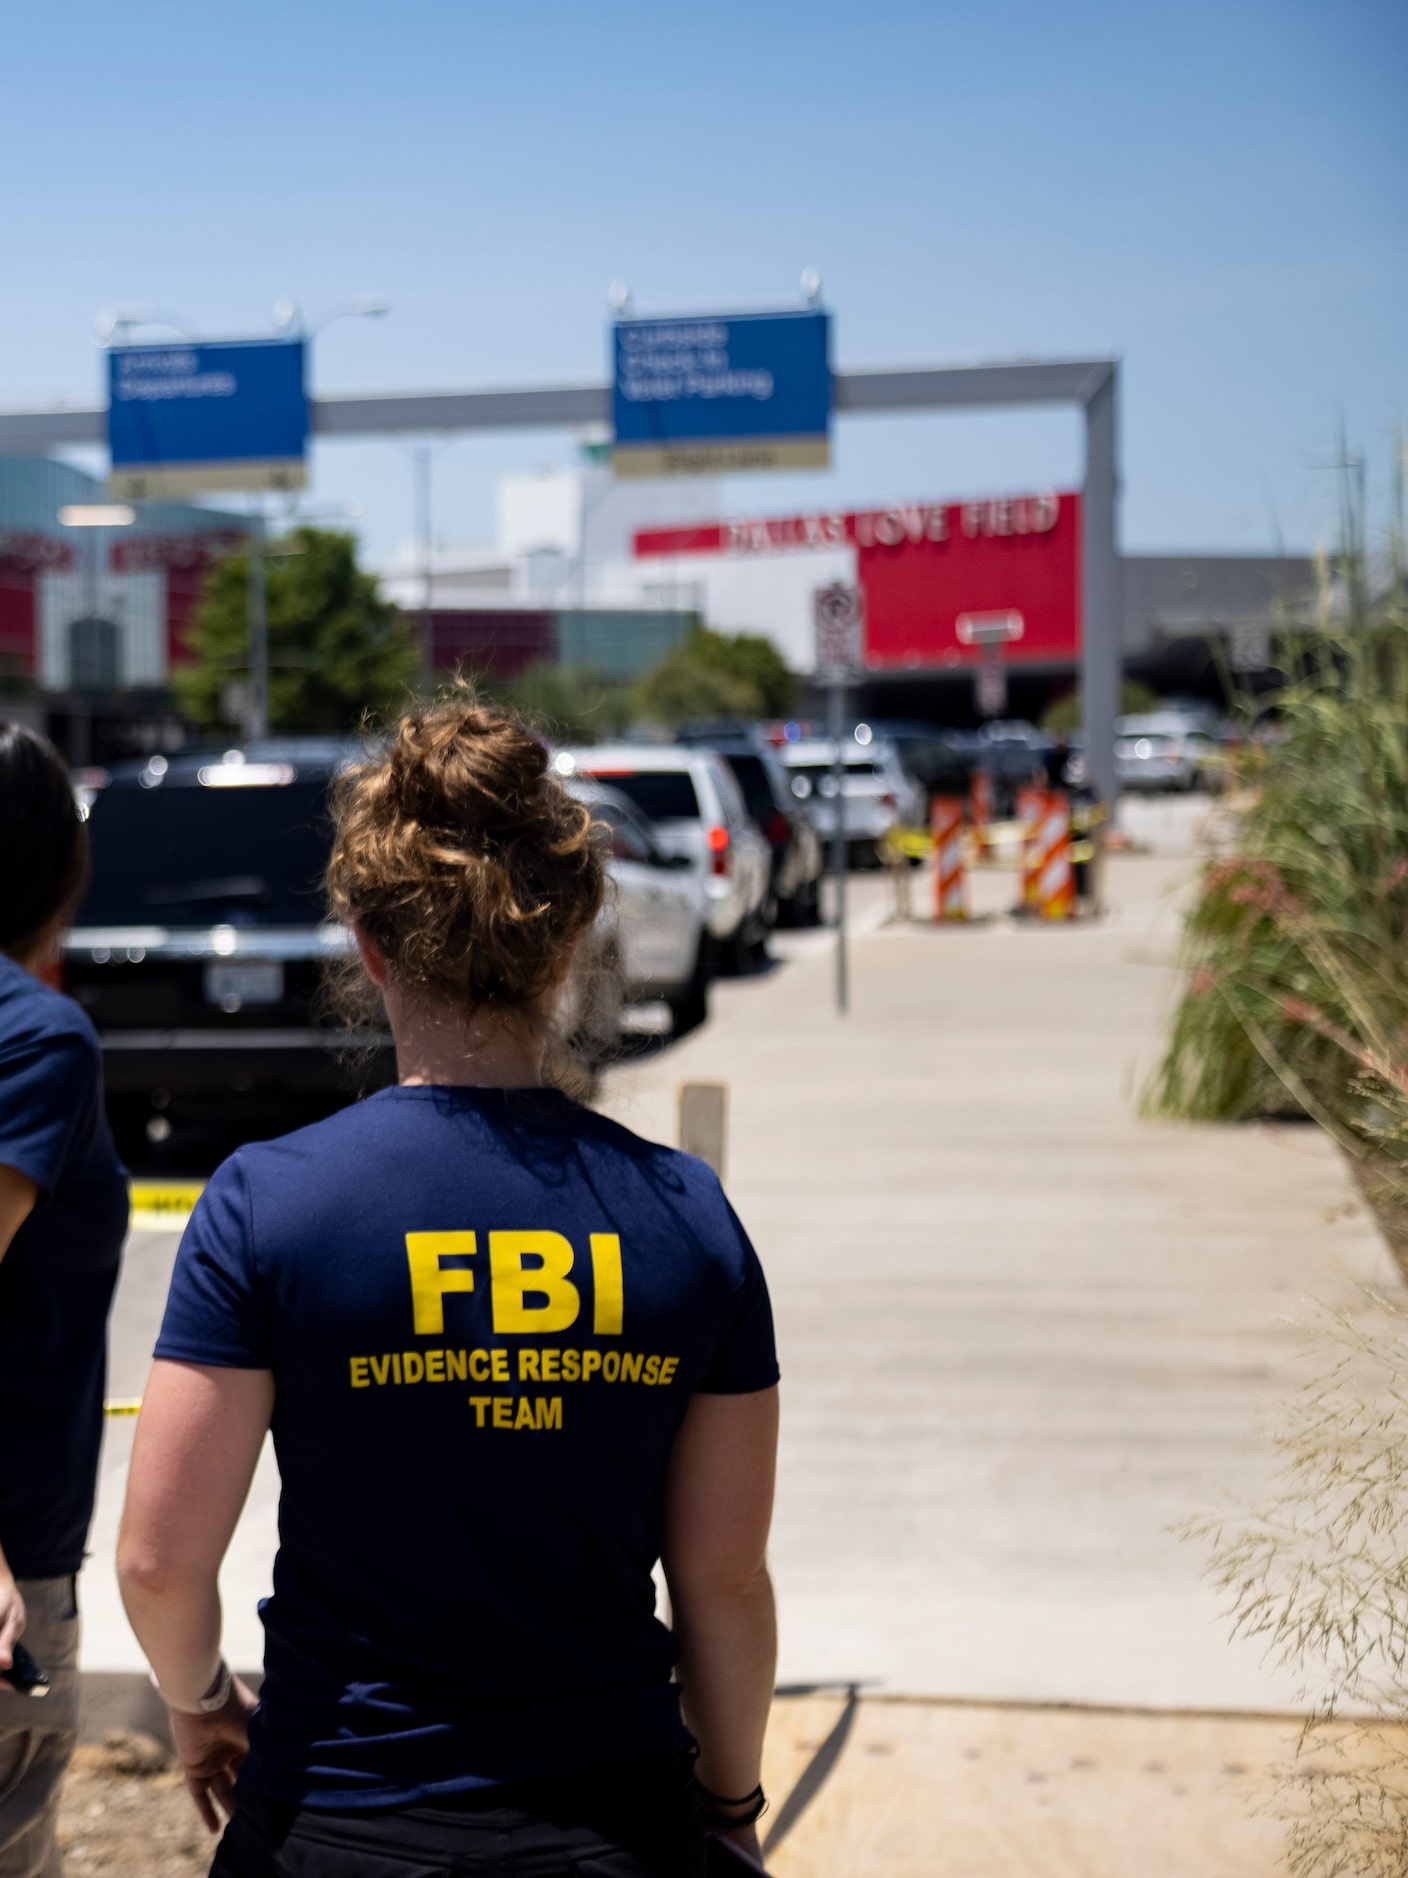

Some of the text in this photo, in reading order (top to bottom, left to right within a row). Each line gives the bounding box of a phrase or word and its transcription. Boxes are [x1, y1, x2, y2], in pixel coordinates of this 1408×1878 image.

[724, 490, 1059, 553] DALLAS LOVE FIELD
[405, 1230, 624, 1336] FBI
[349, 1349, 680, 1388] EVIDENCE RESPONSE
[469, 1397, 563, 1430] TEAM
